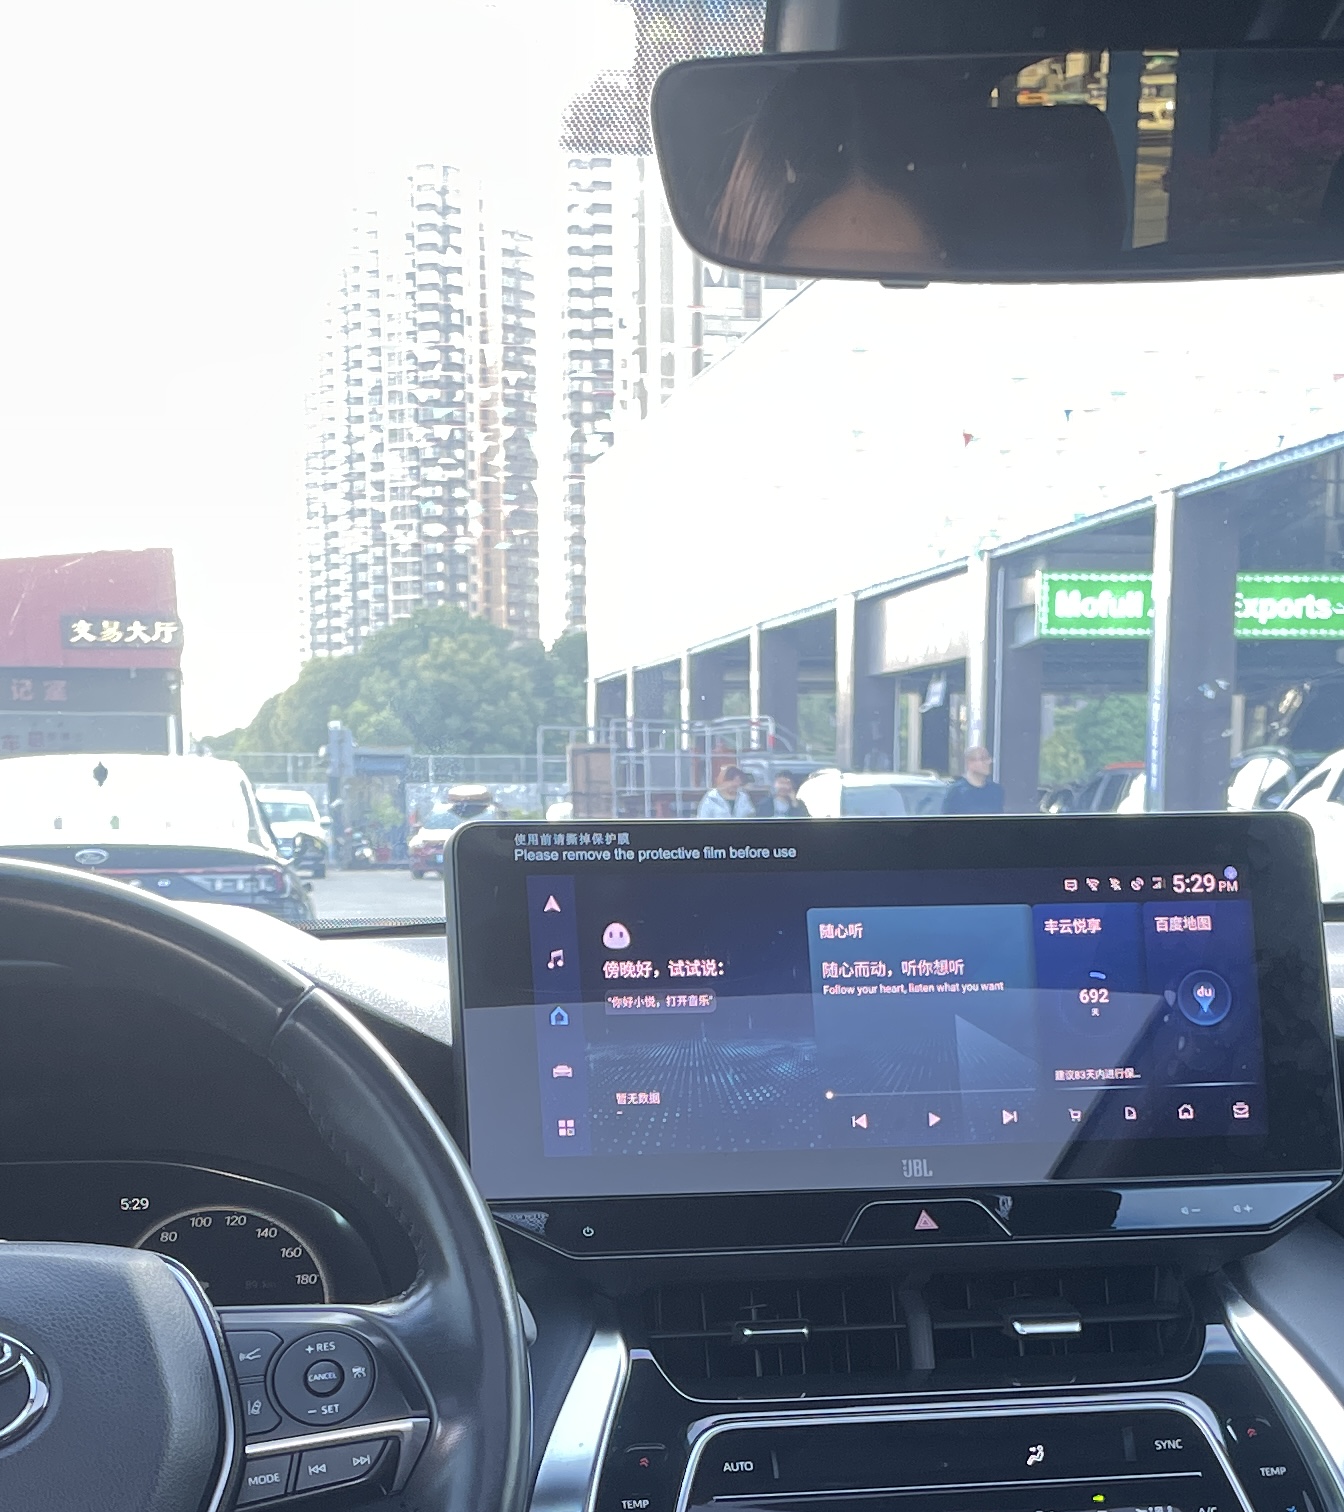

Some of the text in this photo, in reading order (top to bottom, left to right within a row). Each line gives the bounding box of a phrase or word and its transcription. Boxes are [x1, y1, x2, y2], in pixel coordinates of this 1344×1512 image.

[69, 619, 179, 643] 交易大厅
[514, 832, 631, 846] 使用前请撕掉保护膜
[514, 845, 797, 863] Please remove the protective film before use
[1172, 873, 1239, 893] 5:29 PM
[1043, 917, 1102, 934] 丰云悦享
[1154, 915, 1212, 932] 百度地图
[819, 923, 863, 939] 随心听
[822, 959, 965, 979] 随心而动，听你想听
[823, 981, 1004, 996] Follow your heart, listen what you want
[1197, 984, 1212, 997] du
[1079, 988, 1109, 1003] 692
[615, 1092, 661, 1105] 暂无数据
[902, 1159, 933, 1177] JBL
[120, 1197, 150, 1211] 5:29
[190, 1216, 213, 1228] 100
[225, 1214, 247, 1226] 120
[160, 1231, 178, 1243] 80
[256, 1227, 278, 1239] 140
[280, 1246, 303, 1258] 160
[295, 1273, 318, 1285] 180
[308, 1371, 337, 1382] CANCEL
[1154, 1438, 1183, 1450] SYNC
[723, 1460, 754, 1472] AUTO
[1260, 1466, 1287, 1477] TEMP
[248, 1472, 281, 1486] MODE
[621, 1499, 650, 1510] TEMP
